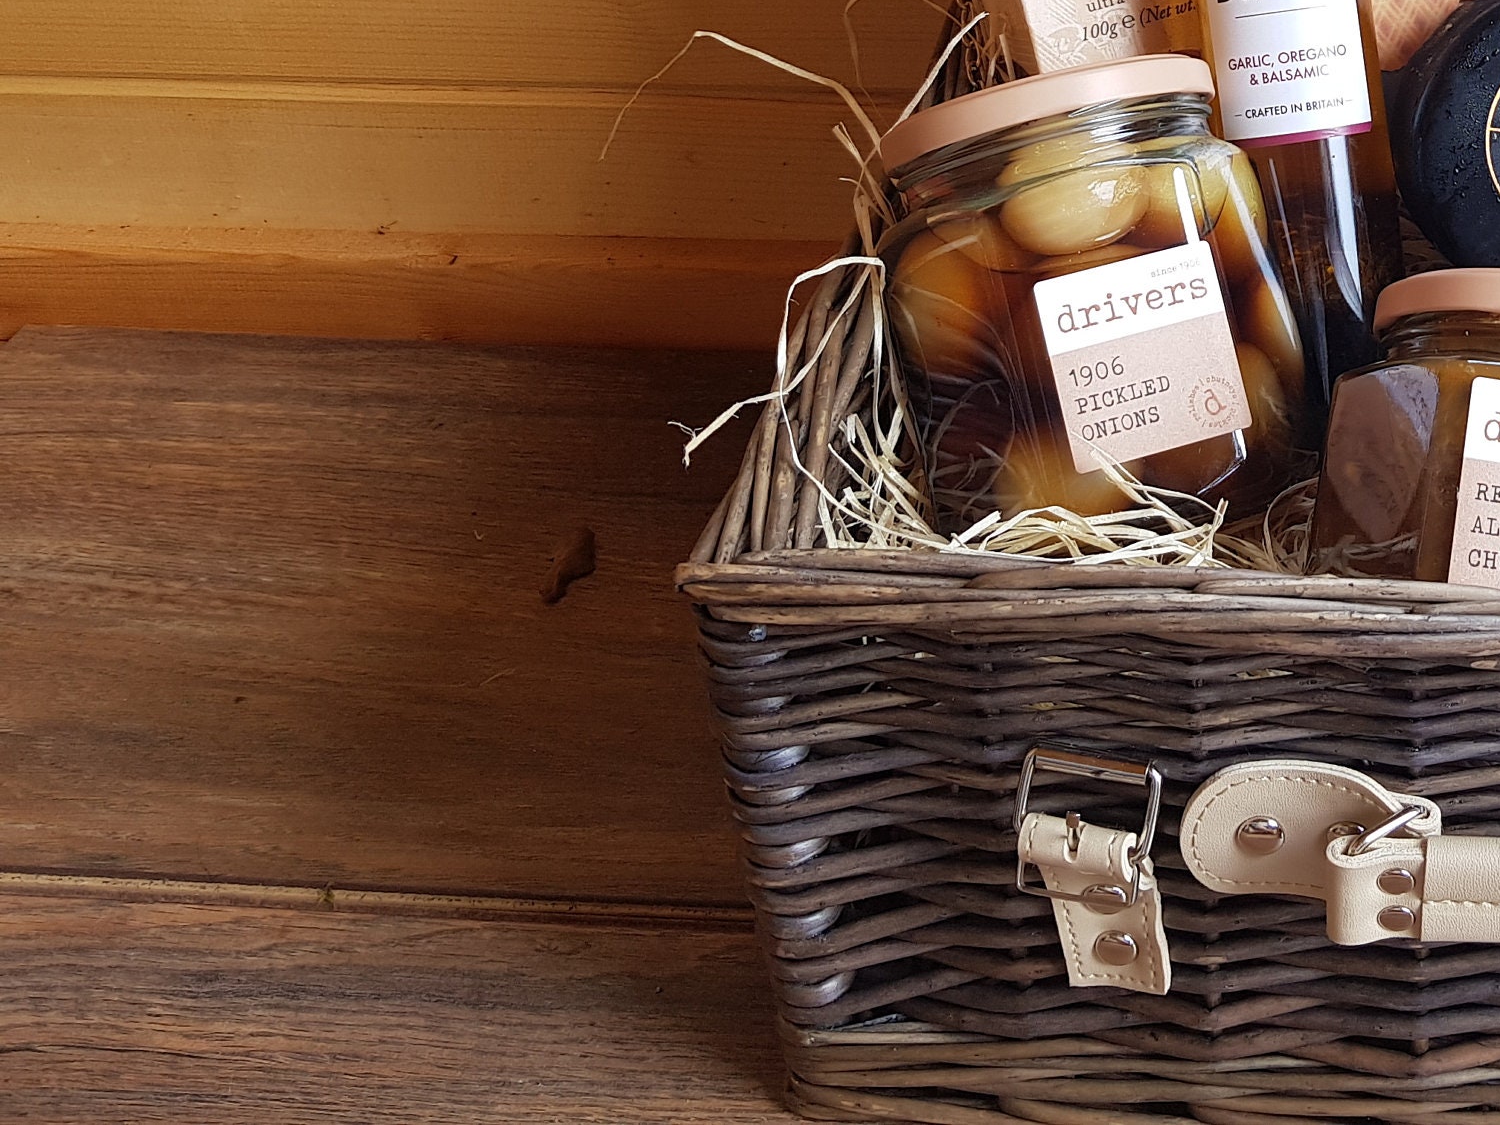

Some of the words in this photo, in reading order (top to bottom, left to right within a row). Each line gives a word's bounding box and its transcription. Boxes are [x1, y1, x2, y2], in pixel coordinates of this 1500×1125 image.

[1082, 20, 1119, 42] 100g
[1140, 4, 1172, 28] (Net
[1228, 52, 1275, 72] GARLIC,
[1277, 44, 1347, 65] OREGANO
[1249, 72, 1260, 86] &
[1261, 64, 1330, 85] BALSAMIC
[1245, 103, 1289, 119] CRAFTED
[1290, 102, 1303, 115] IN
[1304, 96, 1344, 113] BRITAIN
[1151, 266, 1177, 278] since
[1057, 277, 1208, 334] drivers
[1068, 355, 1125, 388] 1906
[1074, 375, 1171, 415] PICKLED
[1082, 406, 1161, 442] ONIONS
